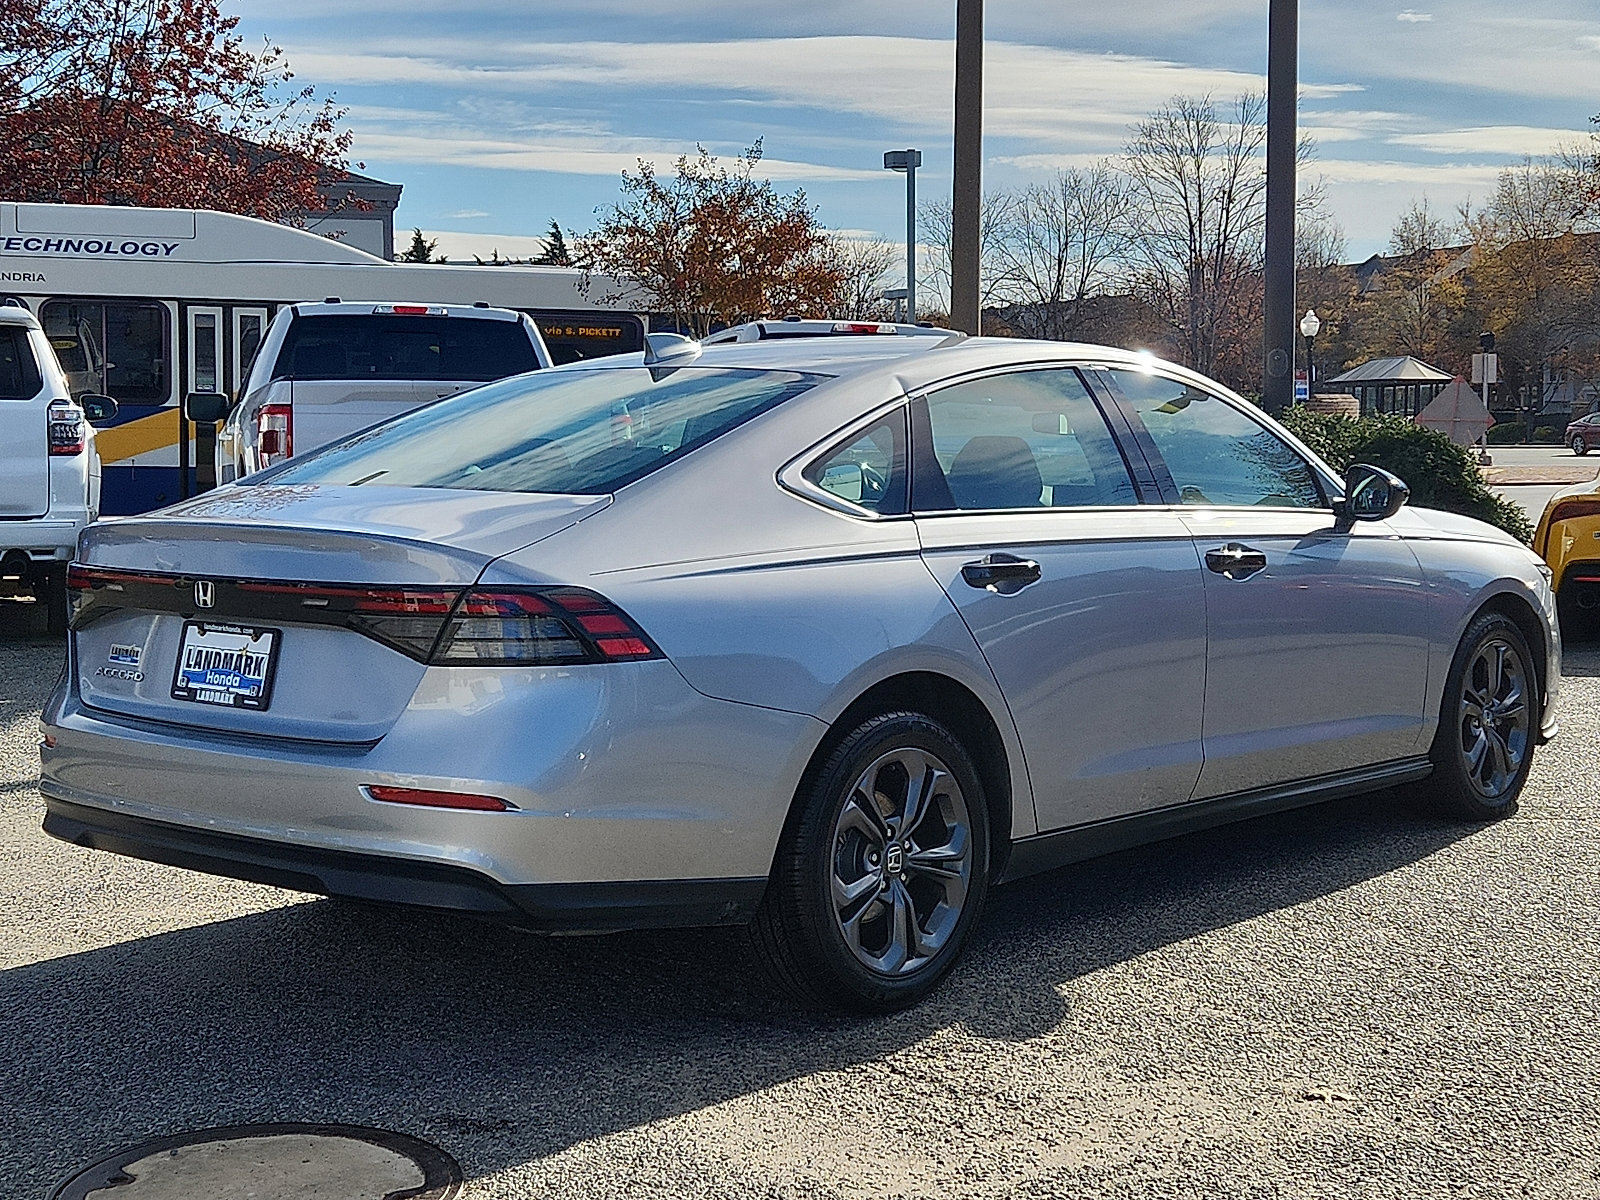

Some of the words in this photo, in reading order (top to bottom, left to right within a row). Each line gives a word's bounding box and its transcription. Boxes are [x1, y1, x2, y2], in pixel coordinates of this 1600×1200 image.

[0, 272, 46, 282] NDRIA
[544, 327, 562, 335] via
[565, 327, 576, 336] S.
[579, 327, 621, 337] PICKETT
[185, 647, 266, 679] LANDMARK
[94, 666, 144, 682] ACCORD
[205, 671, 241, 687] Honda
[196, 689, 235, 705] LANDMARK
